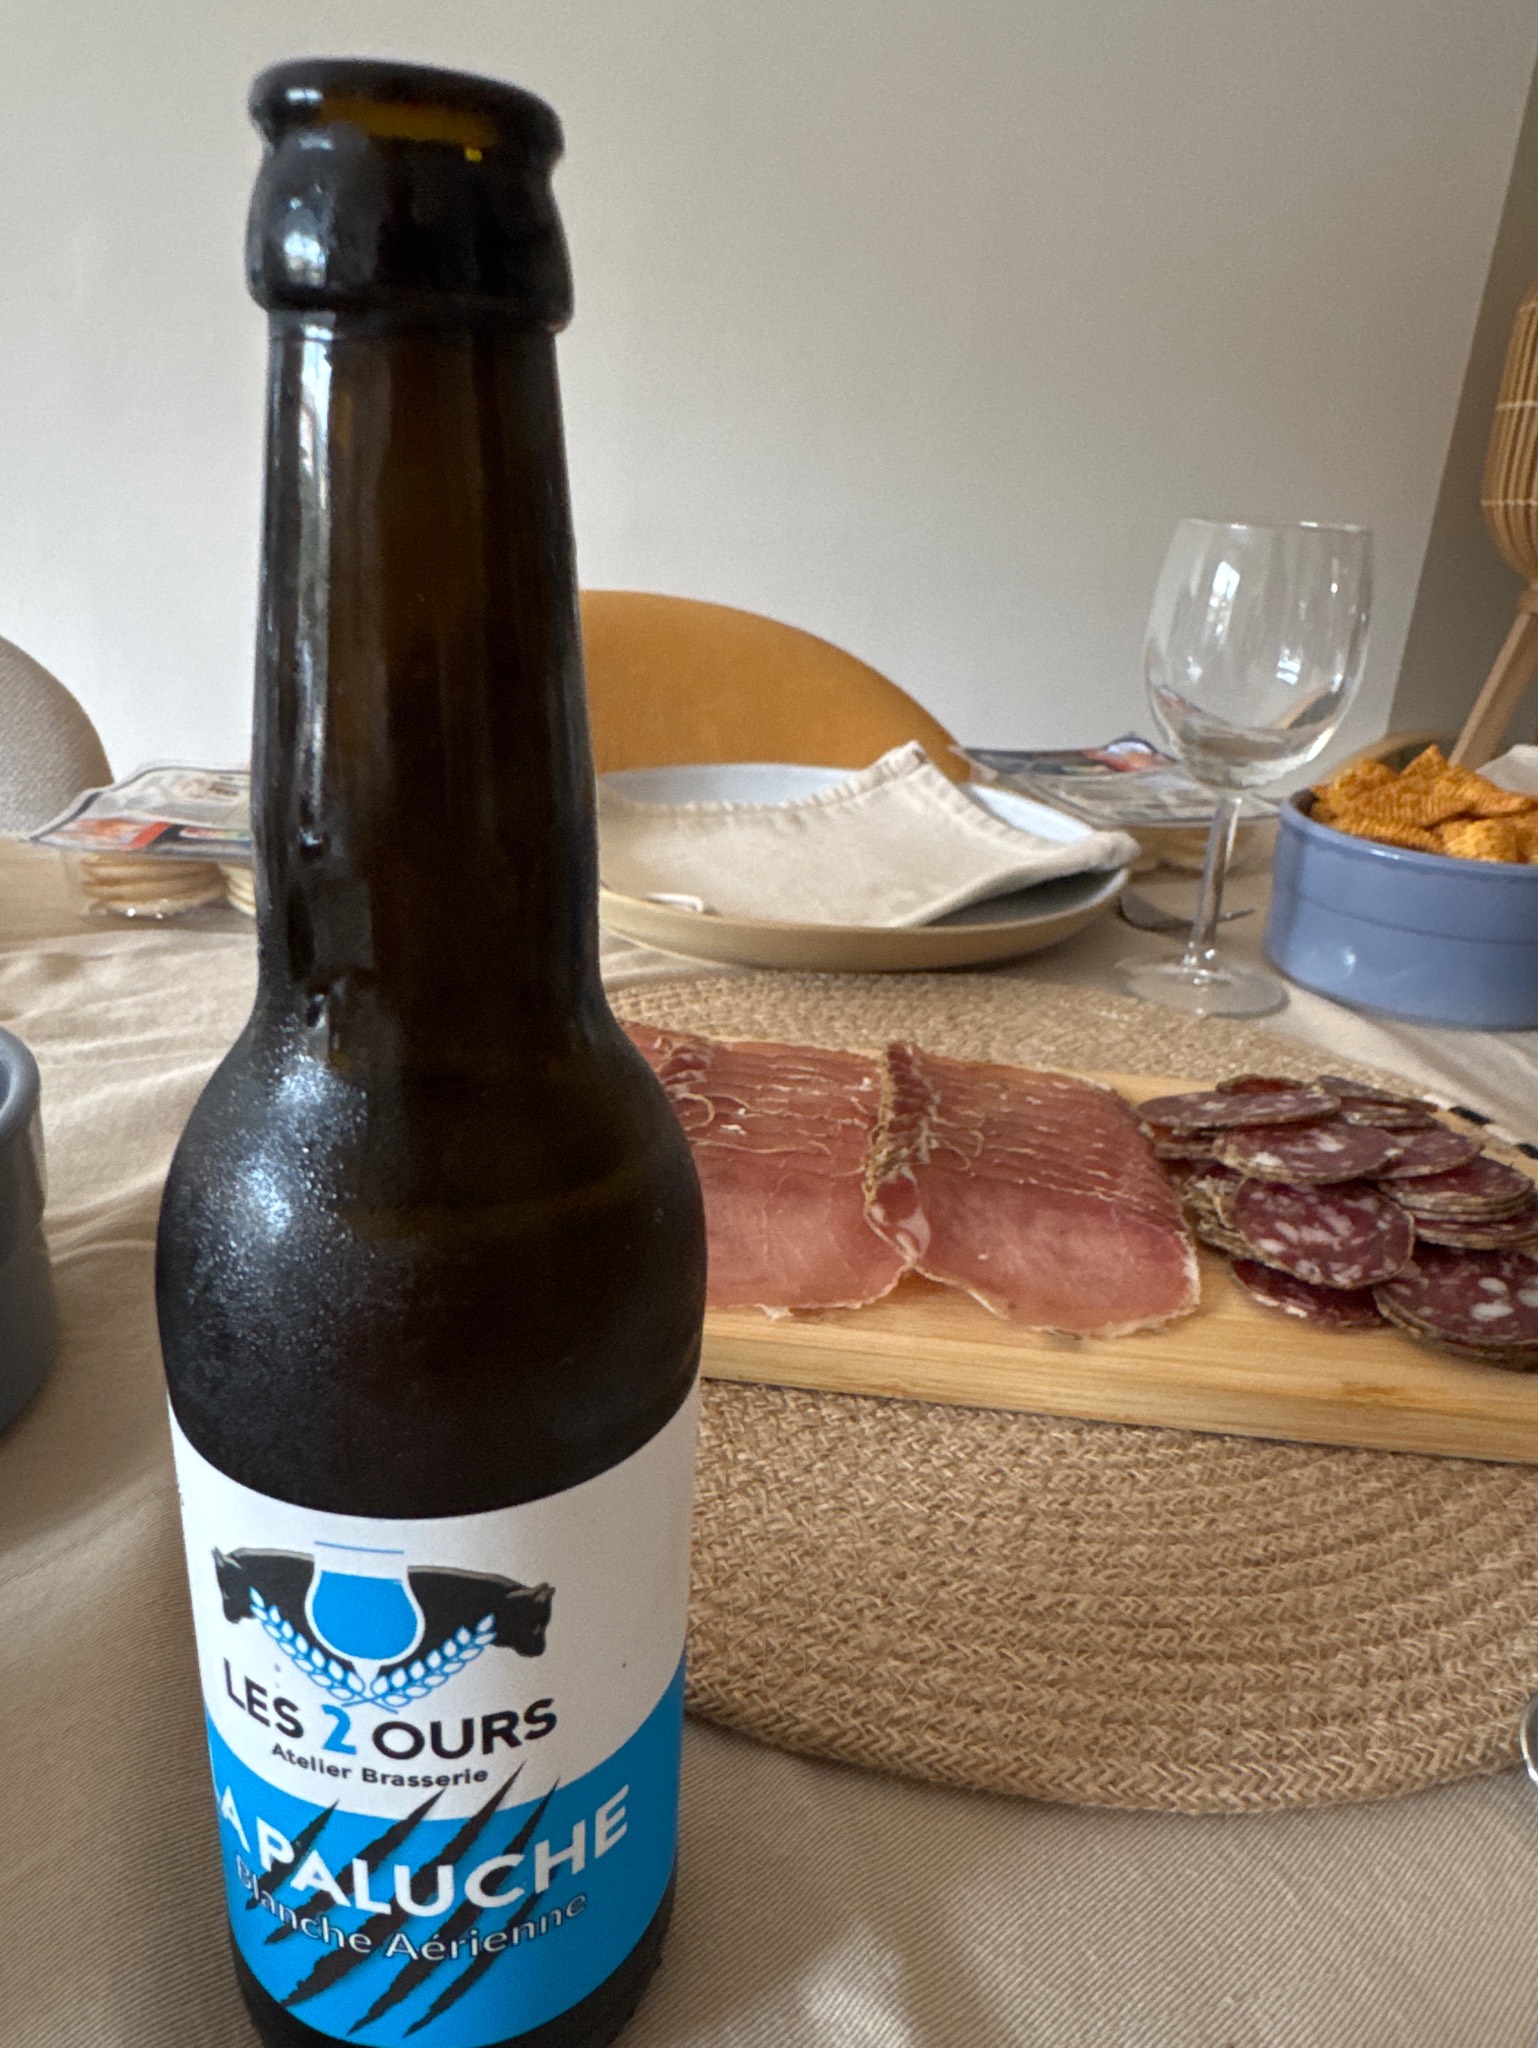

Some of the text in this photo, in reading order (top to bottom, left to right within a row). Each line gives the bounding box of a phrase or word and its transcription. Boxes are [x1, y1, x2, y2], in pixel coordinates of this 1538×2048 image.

[224, 1657, 558, 1760] LES 2 OURS
[271, 1742, 490, 1788] Atelier Brasserie
[217, 1783, 631, 1918] A PALUCHE
[236, 1852, 588, 1962] Blanche Aérienne
